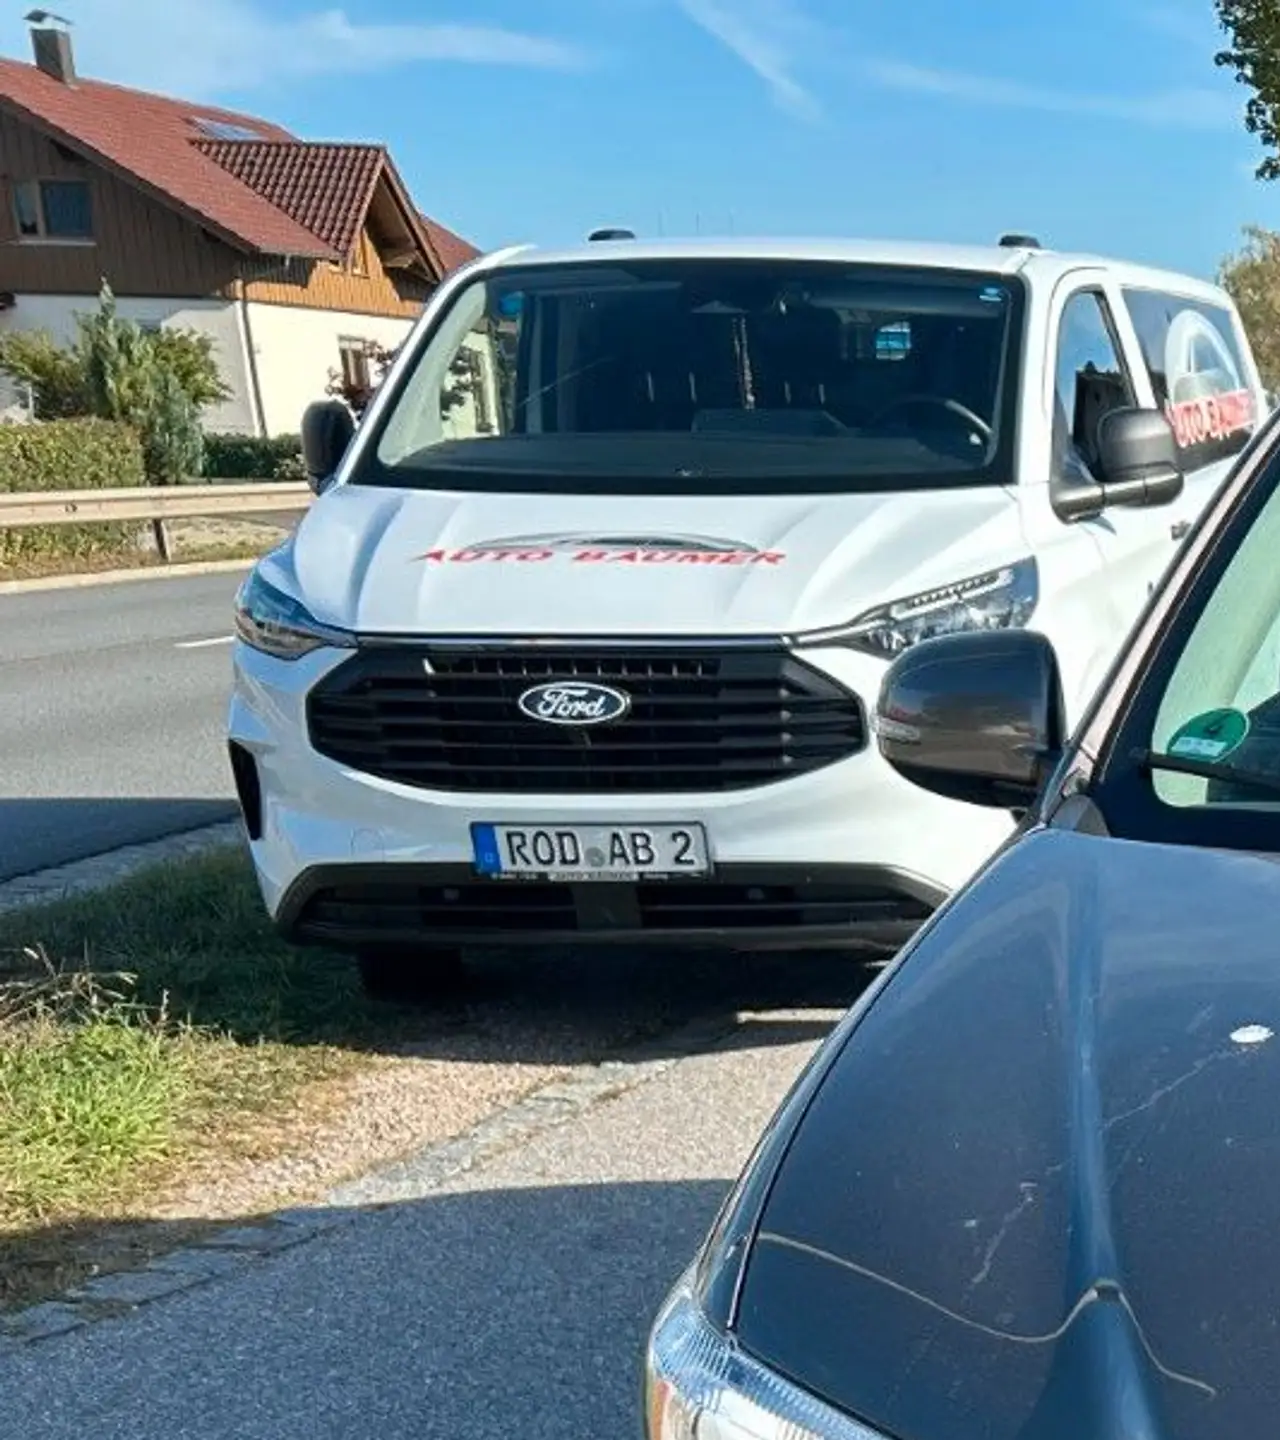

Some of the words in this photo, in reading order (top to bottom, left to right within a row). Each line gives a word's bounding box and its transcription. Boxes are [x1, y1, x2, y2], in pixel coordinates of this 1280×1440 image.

[411, 549, 553, 562] AUTO
[571, 549, 786, 564] BAUMER
[537, 688, 606, 717] Ford
[506, 831, 580, 866] ROD
[609, 832, 655, 866] AB
[671, 830, 695, 866] 2
